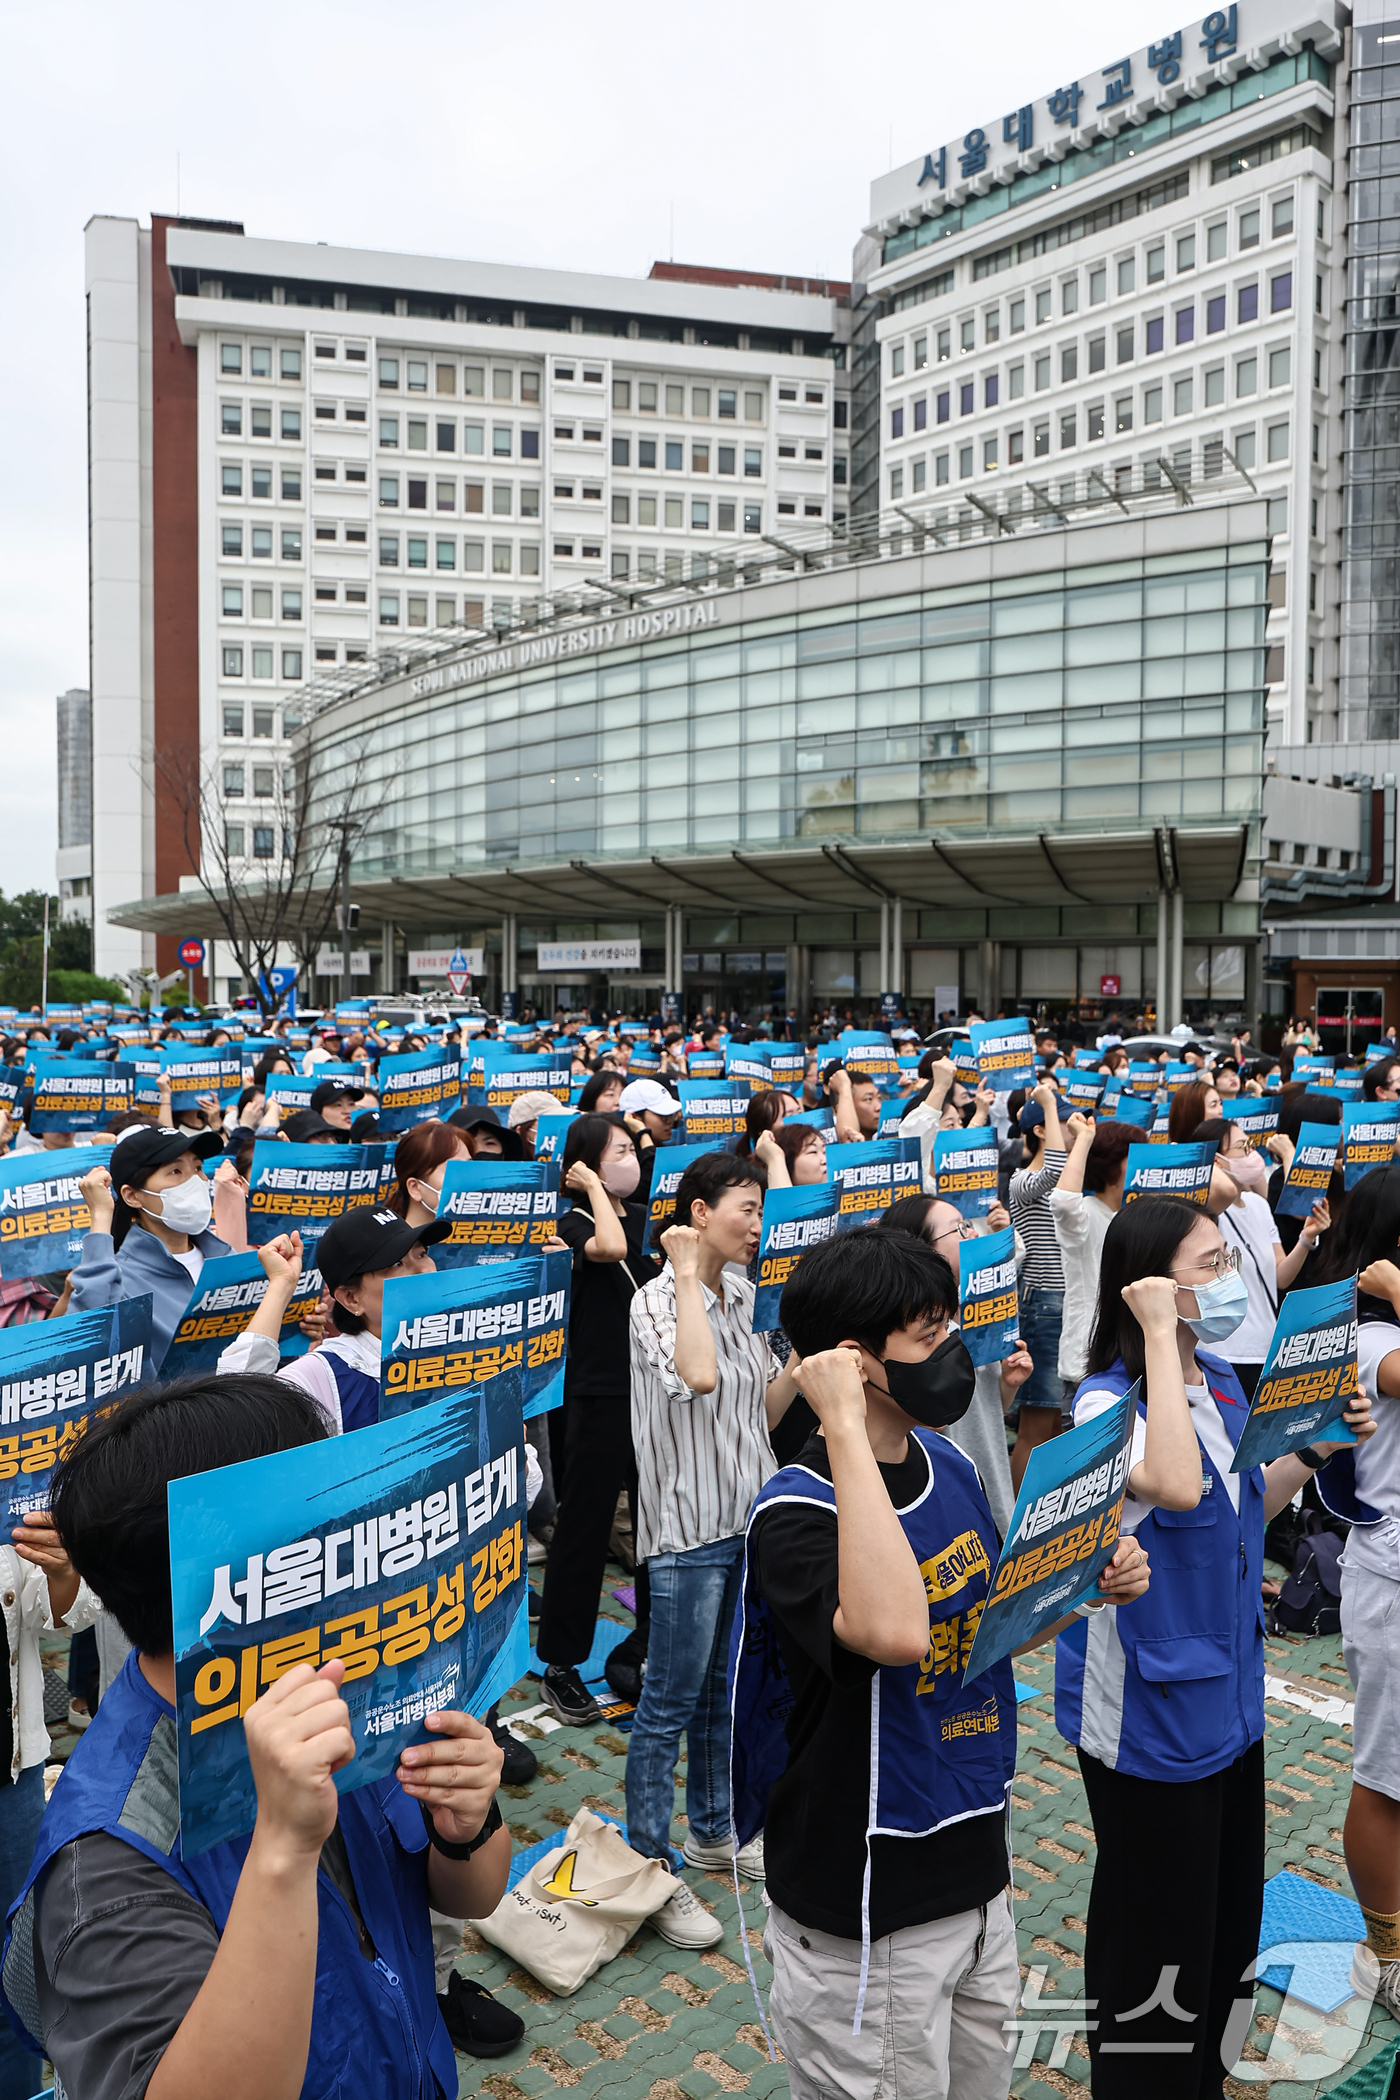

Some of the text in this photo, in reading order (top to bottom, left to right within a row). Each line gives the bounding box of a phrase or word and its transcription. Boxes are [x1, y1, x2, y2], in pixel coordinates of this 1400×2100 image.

[917, 3, 1238, 190] 서울대학교병원
[410, 601, 720, 697] SEOUL NATIONAL UNIVERSITY HOSPITAL
[978, 1034, 1030, 1054] 서울대병원
[166, 1061, 219, 1077] 서울대병원
[221, 1060, 241, 1074] 답게
[979, 1053, 1032, 1072] 의료공공성
[38, 1077, 127, 1094] 서울대병원 답게
[384, 1069, 442, 1090] 서울대병원
[441, 1061, 459, 1081] 답게
[489, 1071, 548, 1088] 서울대병원
[549, 1070, 570, 1085] 답게
[34, 1096, 129, 1112] 의료공공성 강화
[381, 1087, 441, 1109] 의료공공성
[685, 1098, 731, 1115] 서울대병원
[686, 1117, 732, 1134] 의료공공성
[1347, 1123, 1397, 1142] 서울대병원
[257, 1167, 348, 1191] 서울대병원
[349, 1169, 379, 1190] 답게
[893, 1161, 920, 1182] 답게
[1130, 1164, 1212, 1188] 서울대병원 답게
[250, 1192, 345, 1217] 의료공공성
[443, 1190, 557, 1215] 서울대병원 답게
[392, 1290, 566, 1351] 서울대병원 답게
[1270, 1322, 1348, 1370] 서울대병원
[93, 1344, 144, 1399] 답게
[385, 1327, 565, 1396] 의료공공성 강화
[1252, 1366, 1342, 1416] 의료공공성
[1011, 1458, 1114, 1548] 서울대병원
[200, 1446, 518, 1637] 서울대병원 답게
[988, 1518, 1102, 1608] 의료공공성
[190, 1519, 524, 1735] 의료공공성 강화
[364, 1679, 456, 1736] 서울대병원분회
